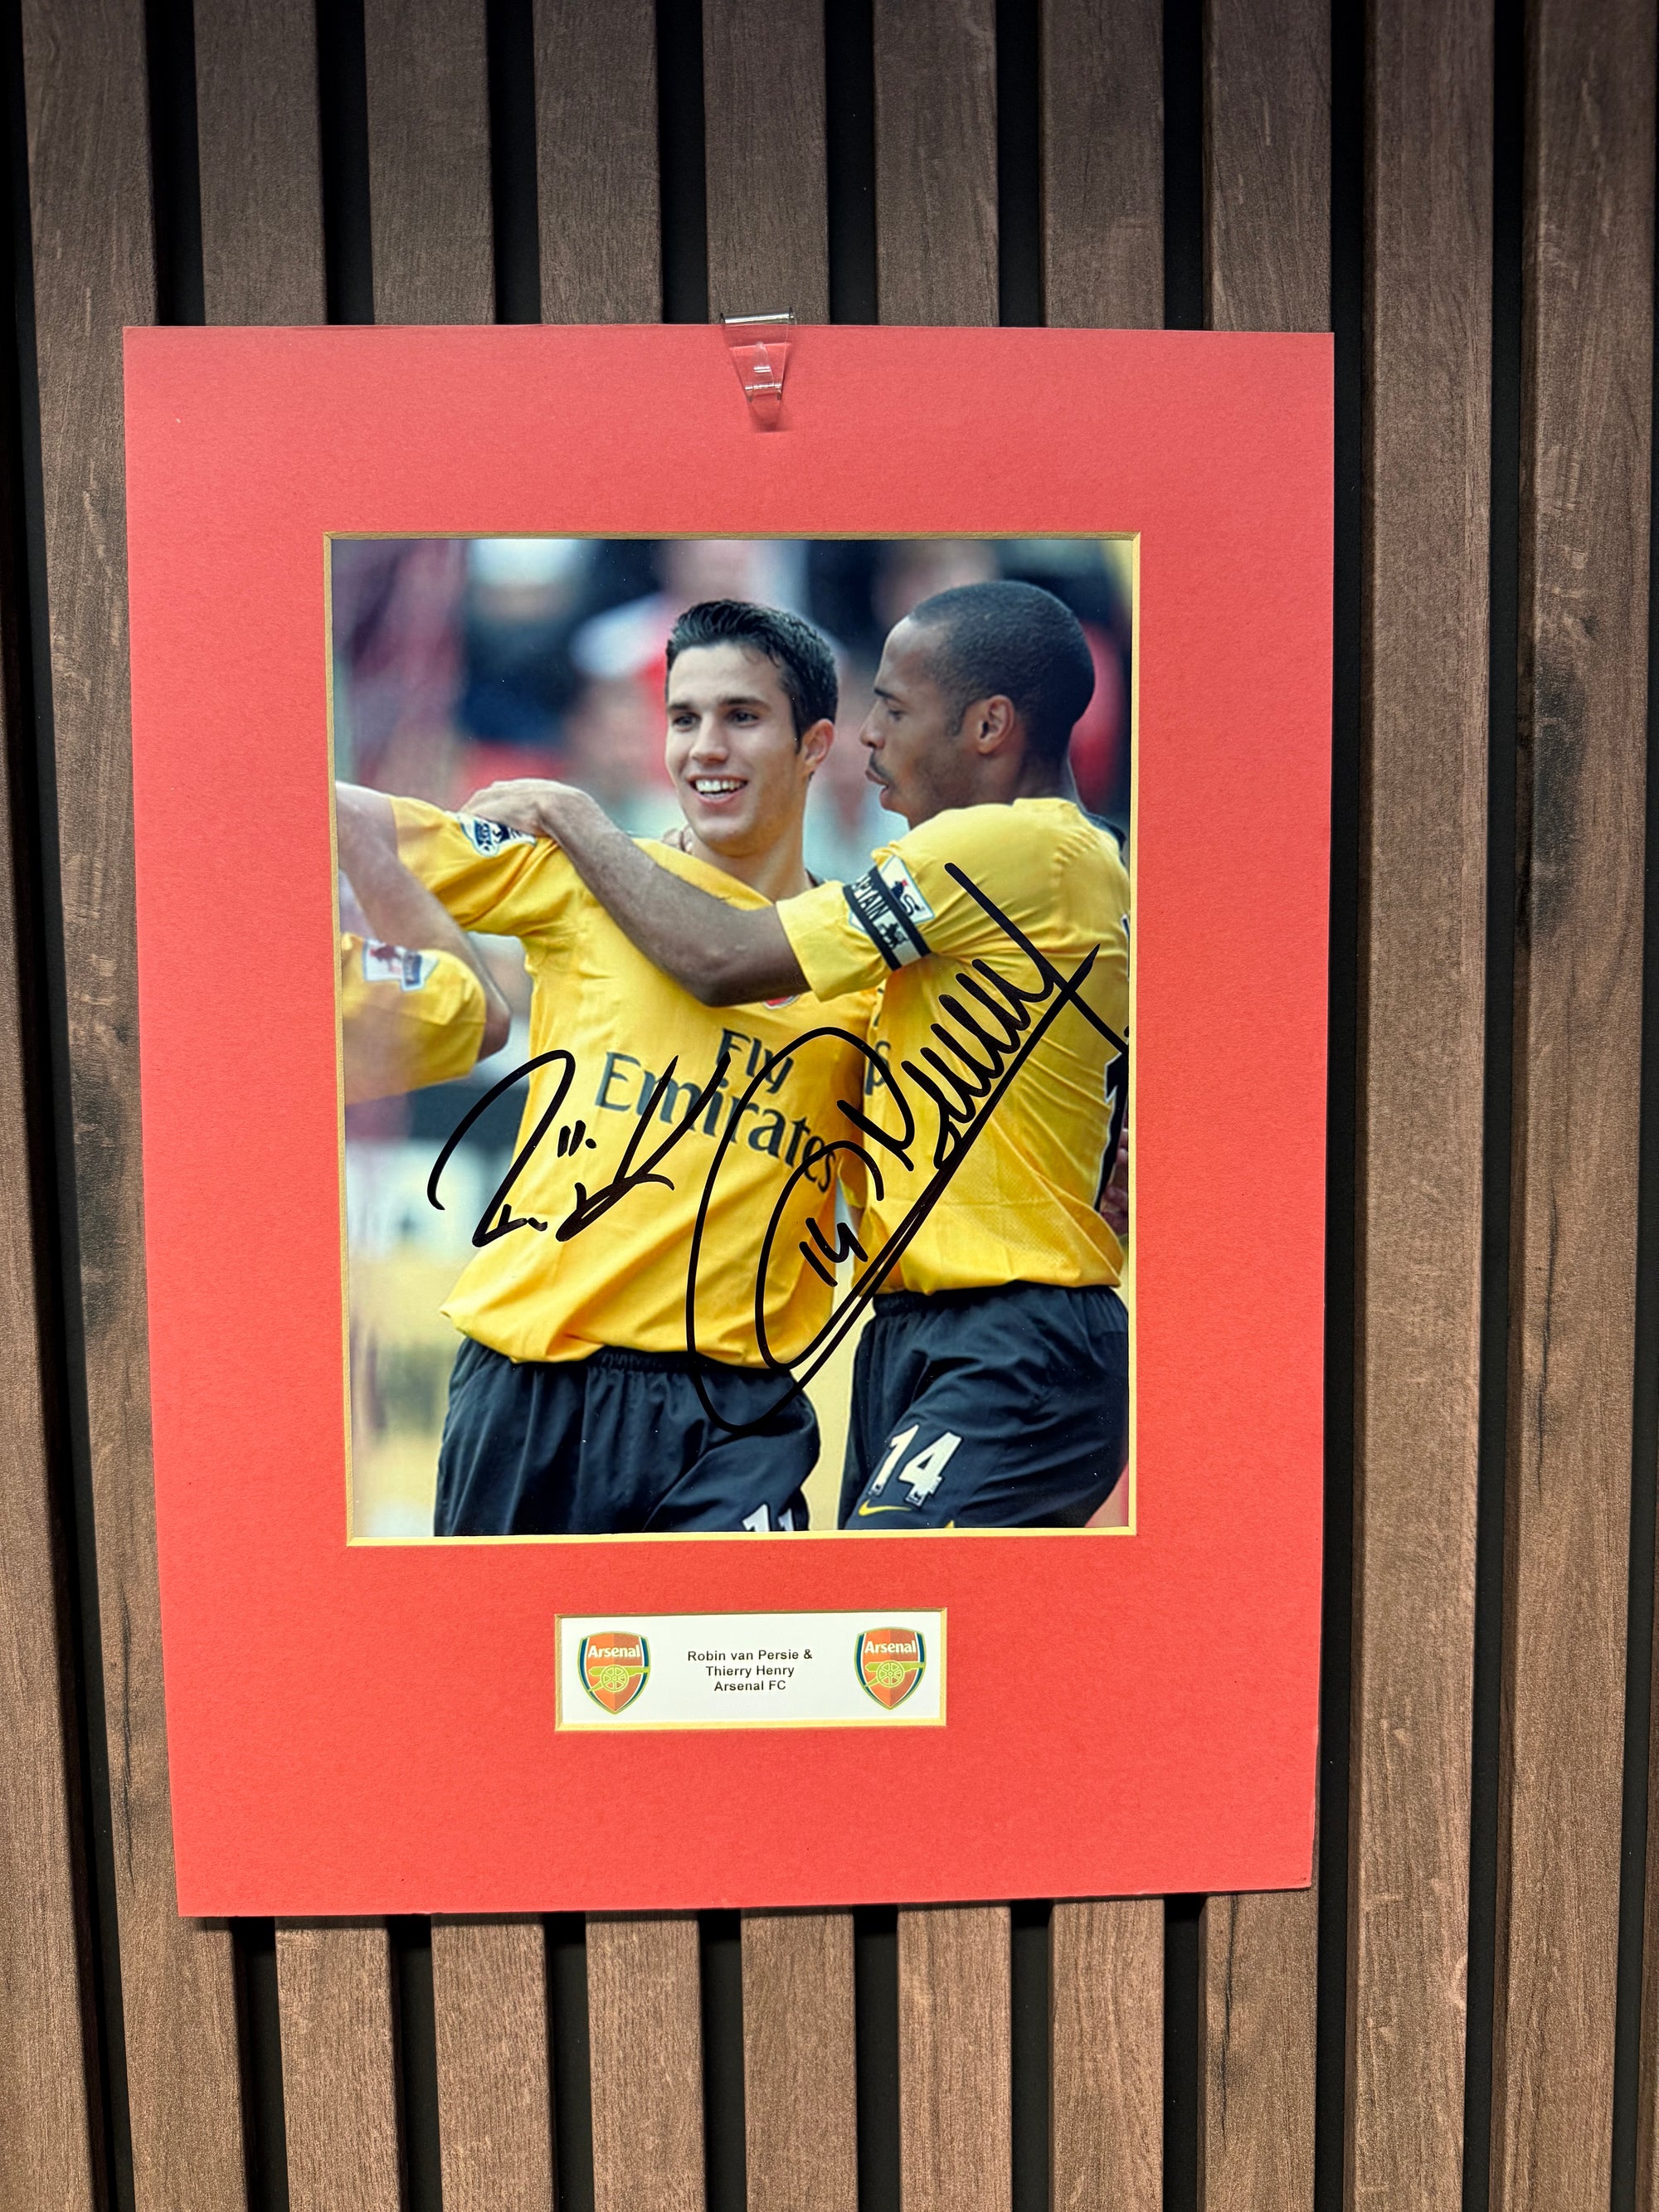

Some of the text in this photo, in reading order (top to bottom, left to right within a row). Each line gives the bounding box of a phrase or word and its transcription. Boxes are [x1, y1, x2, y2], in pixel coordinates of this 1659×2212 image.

[715, 1027, 794, 1095] Fly
[594, 1051, 836, 1193] Emirates
[868, 1423, 964, 1508] 14
[588, 1645, 641, 1659] Arsenal
[864, 1640, 917, 1655] Arsenal
[688, 1649, 813, 1661] Robin van Persie &
[705, 1665, 795, 1679] Thierry Henry
[713, 1680, 786, 1692] Arsenal FC
